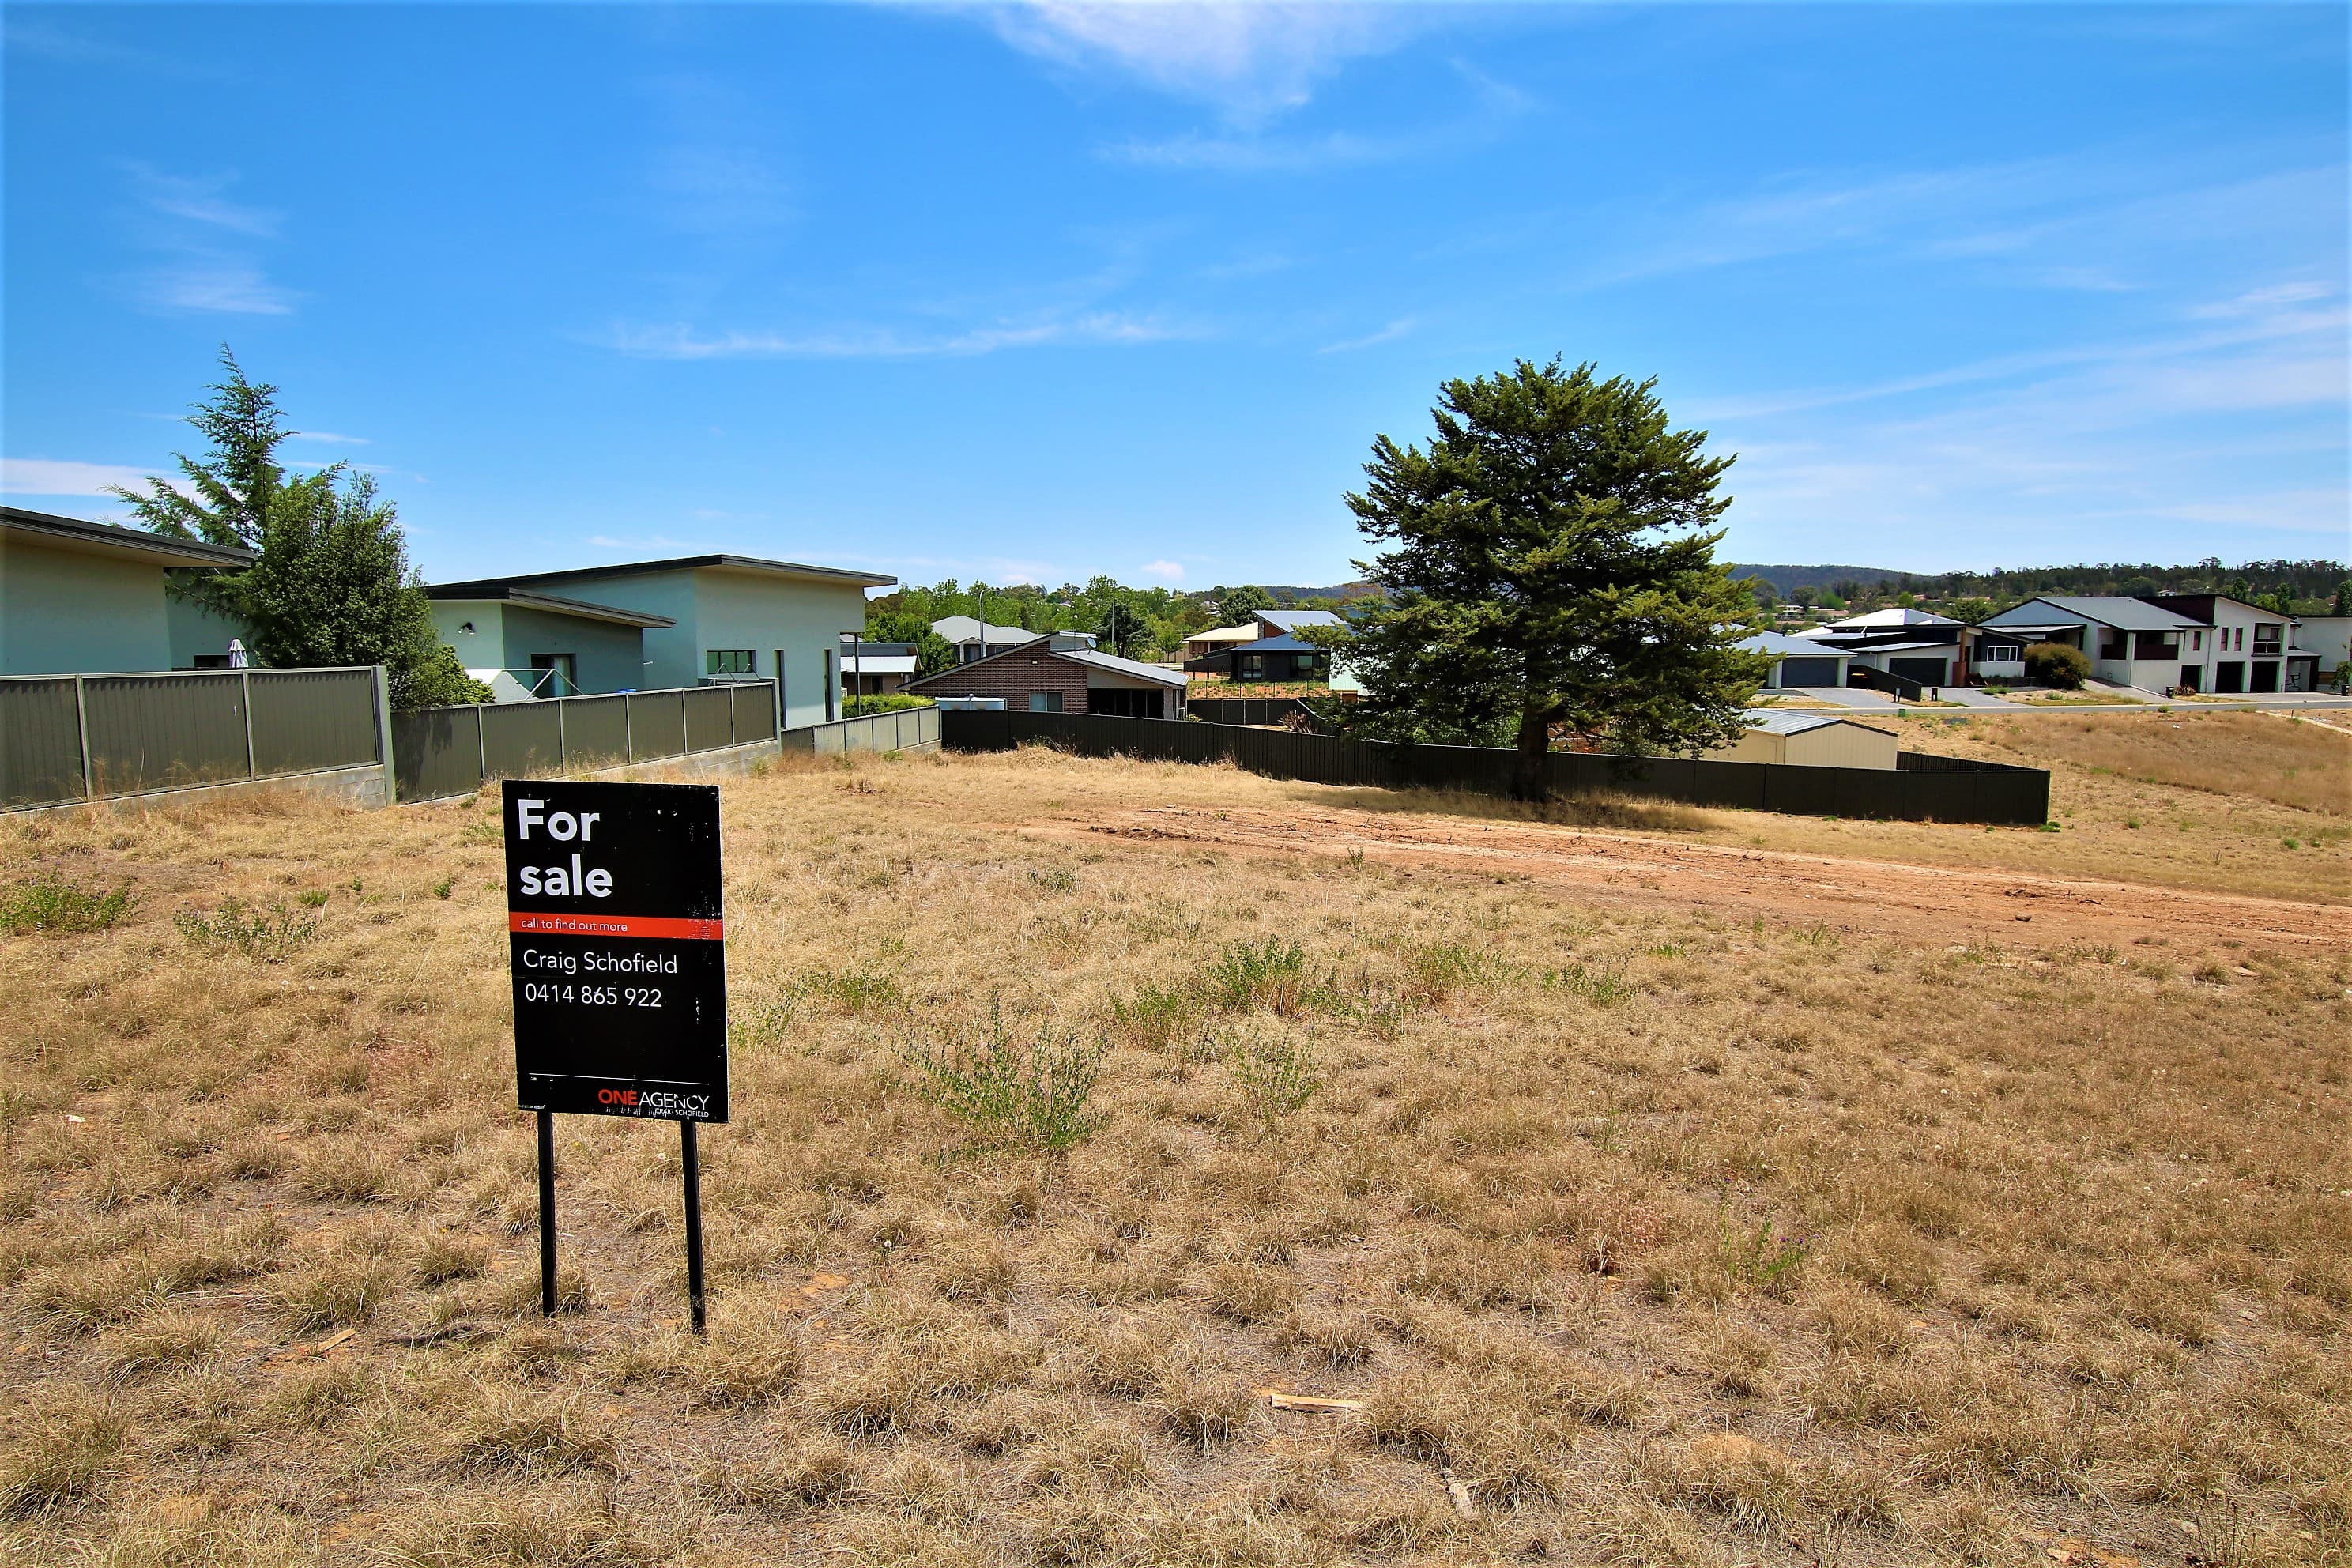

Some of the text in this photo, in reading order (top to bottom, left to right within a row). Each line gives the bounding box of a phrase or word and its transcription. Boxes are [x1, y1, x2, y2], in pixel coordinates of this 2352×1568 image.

[518, 799, 600, 841] For
[520, 853, 613, 898] sale
[521, 918, 628, 932] call to find out more
[523, 949, 677, 974] Craig Schofield
[525, 983, 662, 1008] 0414 865 922
[675, 1109, 710, 1118] SCHOFIELD
